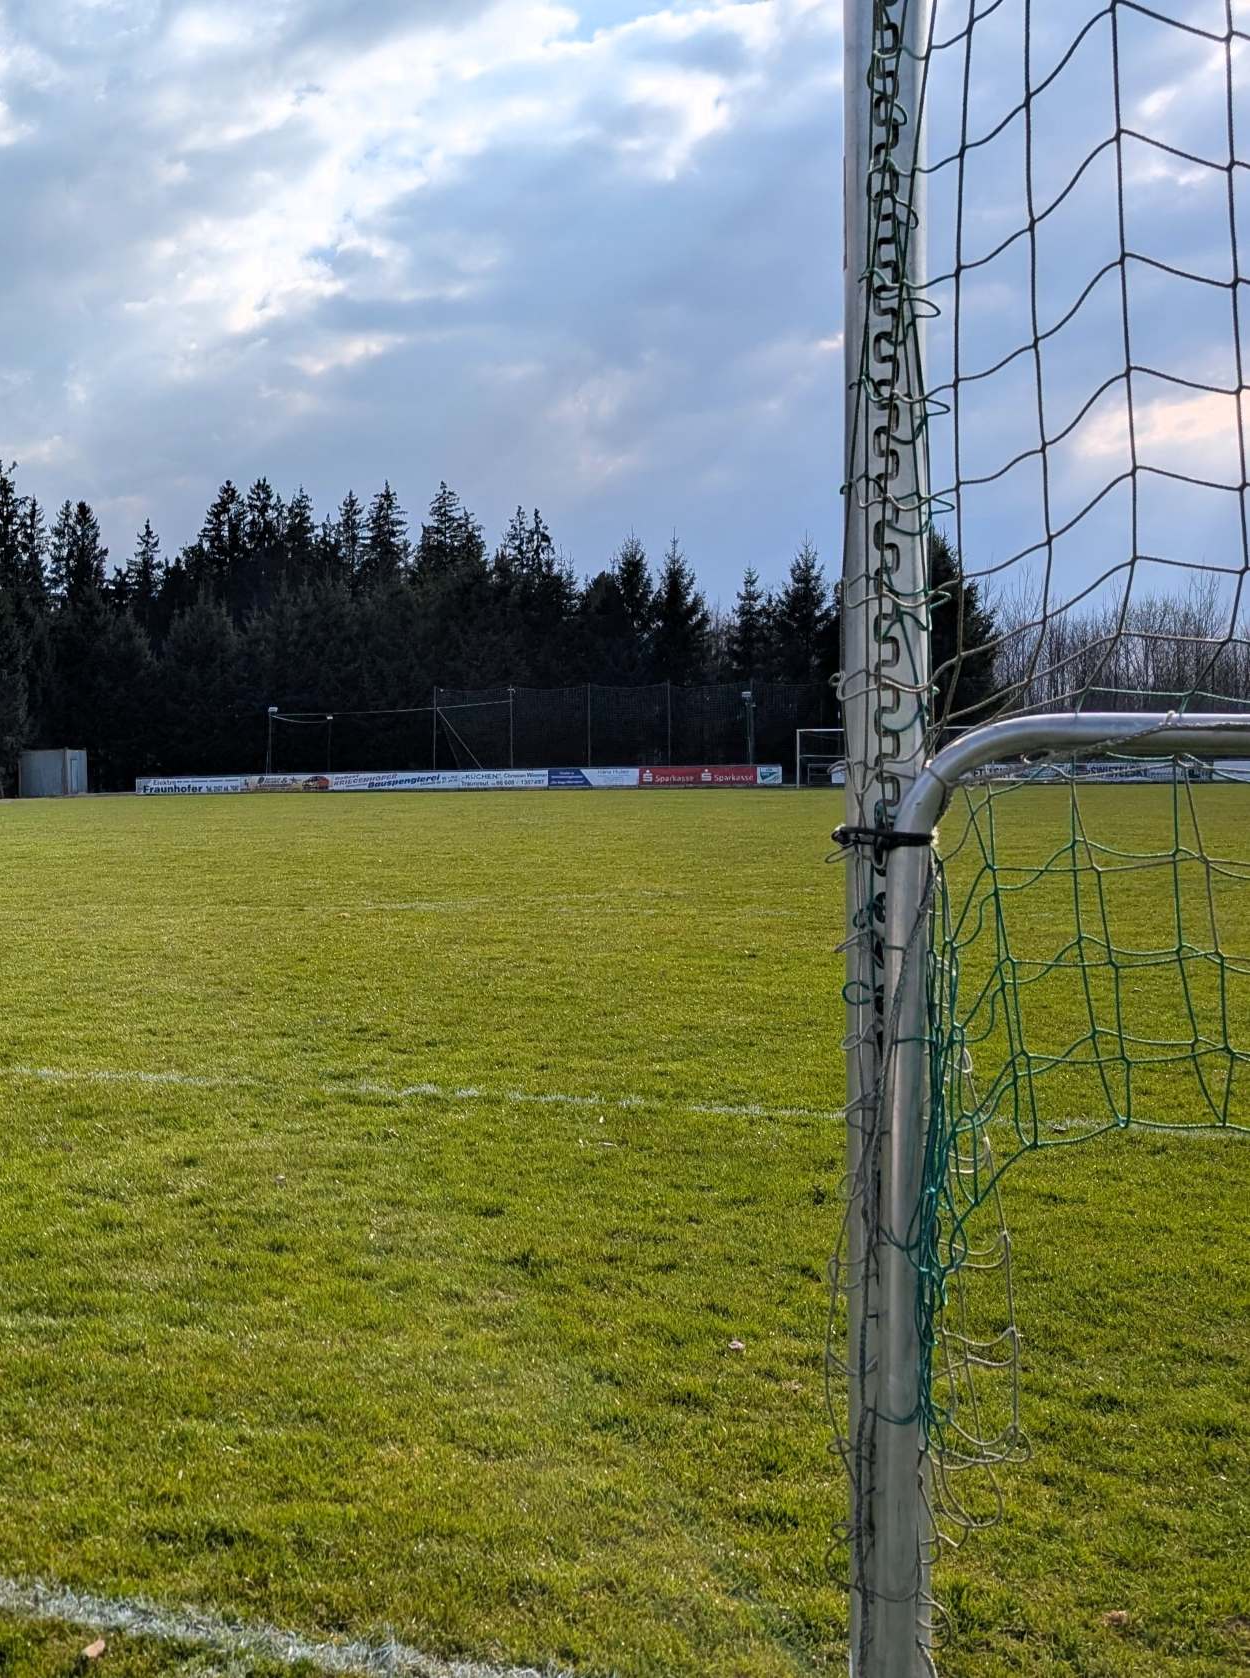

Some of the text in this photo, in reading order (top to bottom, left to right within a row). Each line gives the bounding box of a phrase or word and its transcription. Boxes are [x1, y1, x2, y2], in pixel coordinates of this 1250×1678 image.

[368, 774, 440, 788] Bauspenglerei
[655, 775, 695, 783] Sparkasse
[714, 774, 754, 782] Sparkasse
[143, 784, 203, 793] Fraunhofer
